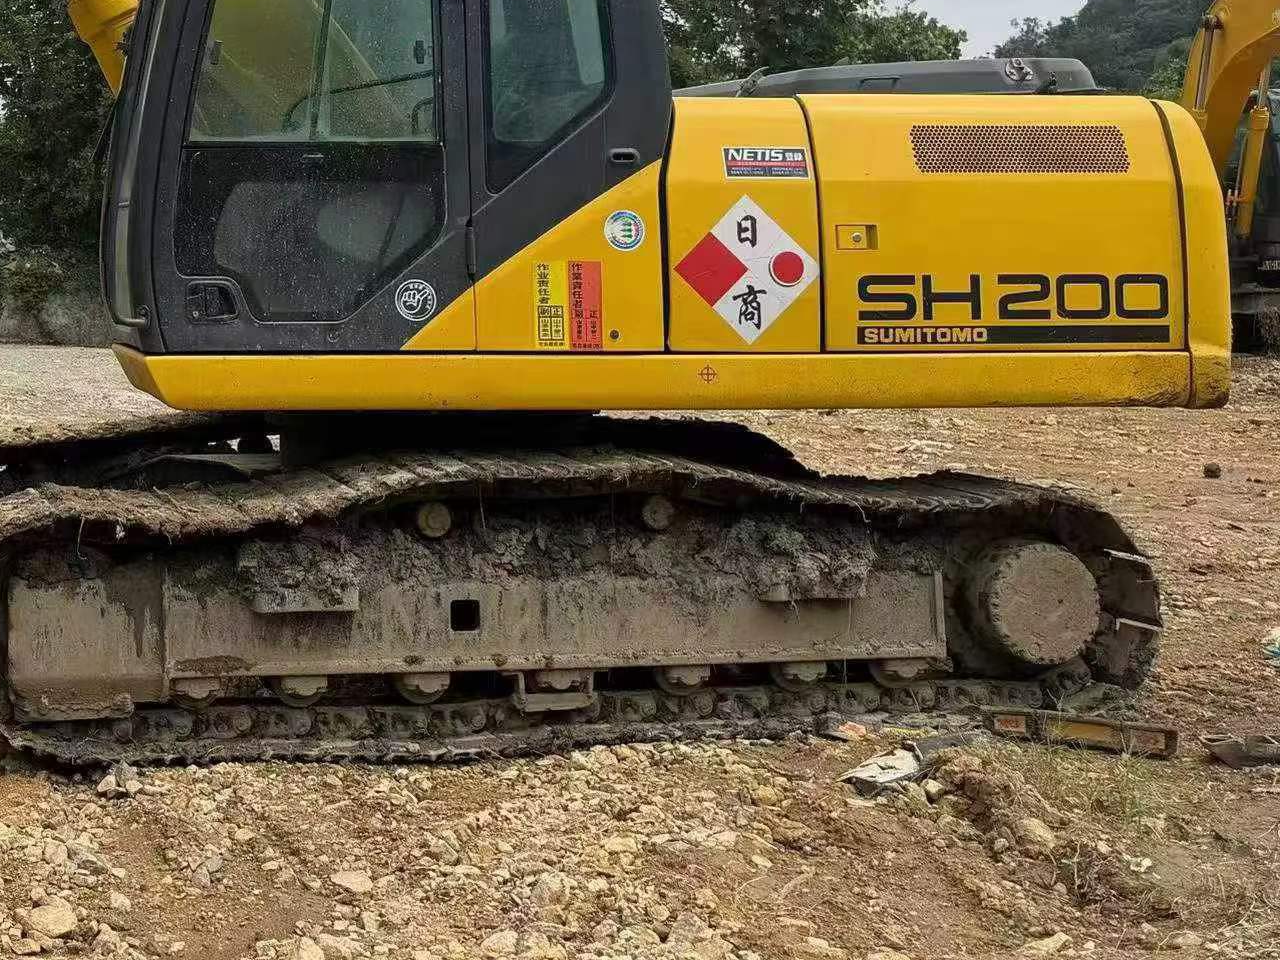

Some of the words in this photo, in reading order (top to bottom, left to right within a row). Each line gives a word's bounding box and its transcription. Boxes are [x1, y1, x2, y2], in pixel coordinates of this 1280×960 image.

[727, 148, 784, 161] NETIS
[857, 274, 982, 321] SH
[997, 273, 1169, 320] 200
[864, 327, 988, 343] SUMITOMO
